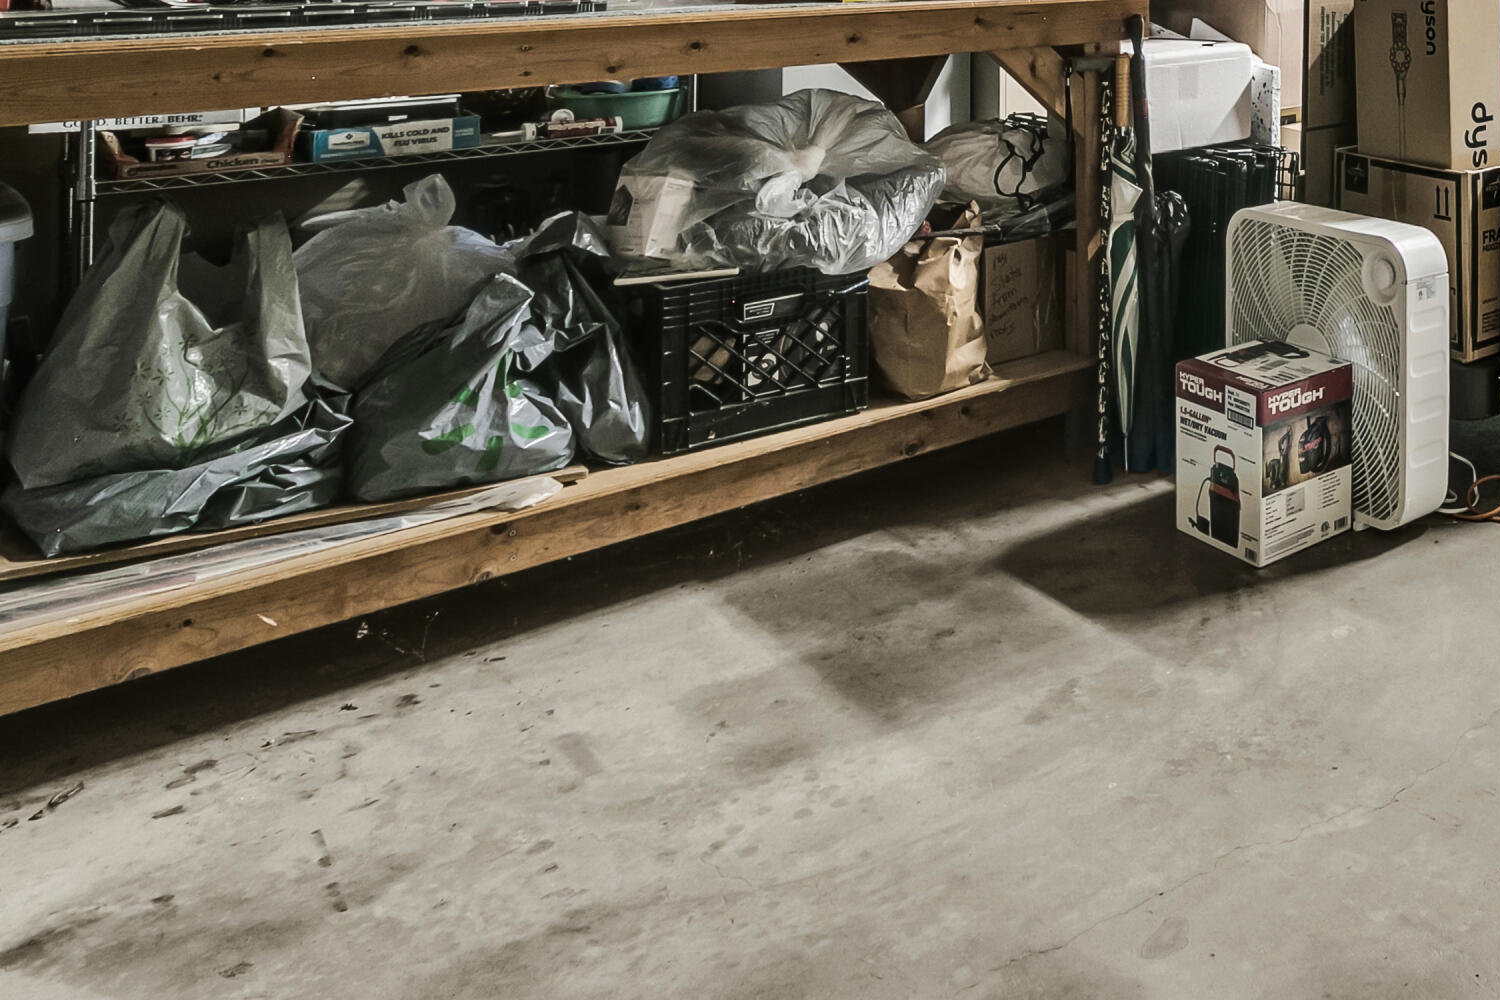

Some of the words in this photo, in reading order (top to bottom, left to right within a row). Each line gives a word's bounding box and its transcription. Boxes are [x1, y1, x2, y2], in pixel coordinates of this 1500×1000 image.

[381, 131, 405, 140] KILLS
[406, 128, 430, 138] COLD
[431, 126, 450, 136] AND
[1464, 101, 1494, 168] dys
[411, 136, 438, 147] VIRUS
[206, 157, 260, 169] Chicken
[1179, 371, 1205, 384] HYPER
[1179, 378, 1223, 404] TOUGH
[1268, 388, 1302, 404] HYPER
[1267, 387, 1324, 415] TOUGH
[1204, 424, 1228, 441] VACUUM
